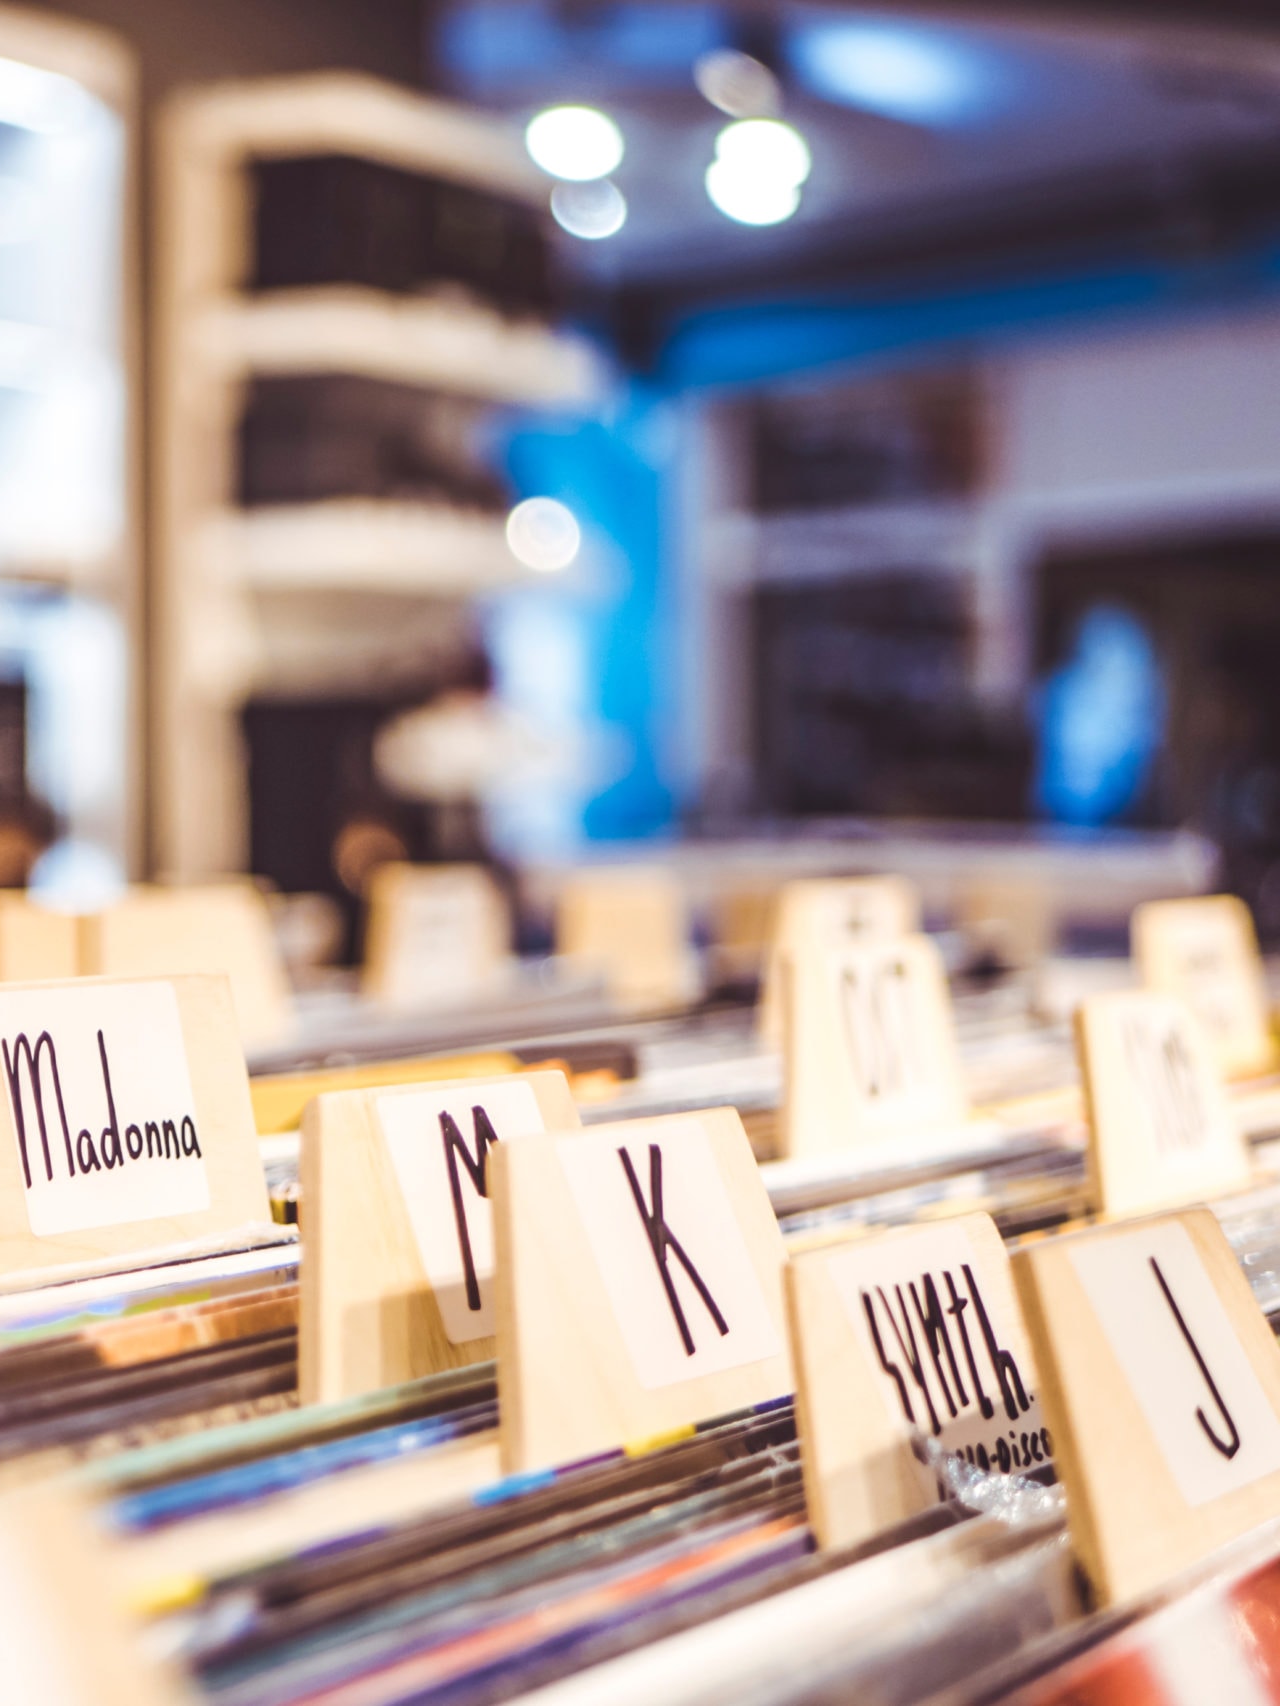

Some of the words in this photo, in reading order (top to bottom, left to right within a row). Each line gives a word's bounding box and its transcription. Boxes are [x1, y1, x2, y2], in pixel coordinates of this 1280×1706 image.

[1, 1029, 202, 1189] Madonna
[617, 1143, 730, 1357] K
[1149, 1256, 1242, 1461] J
